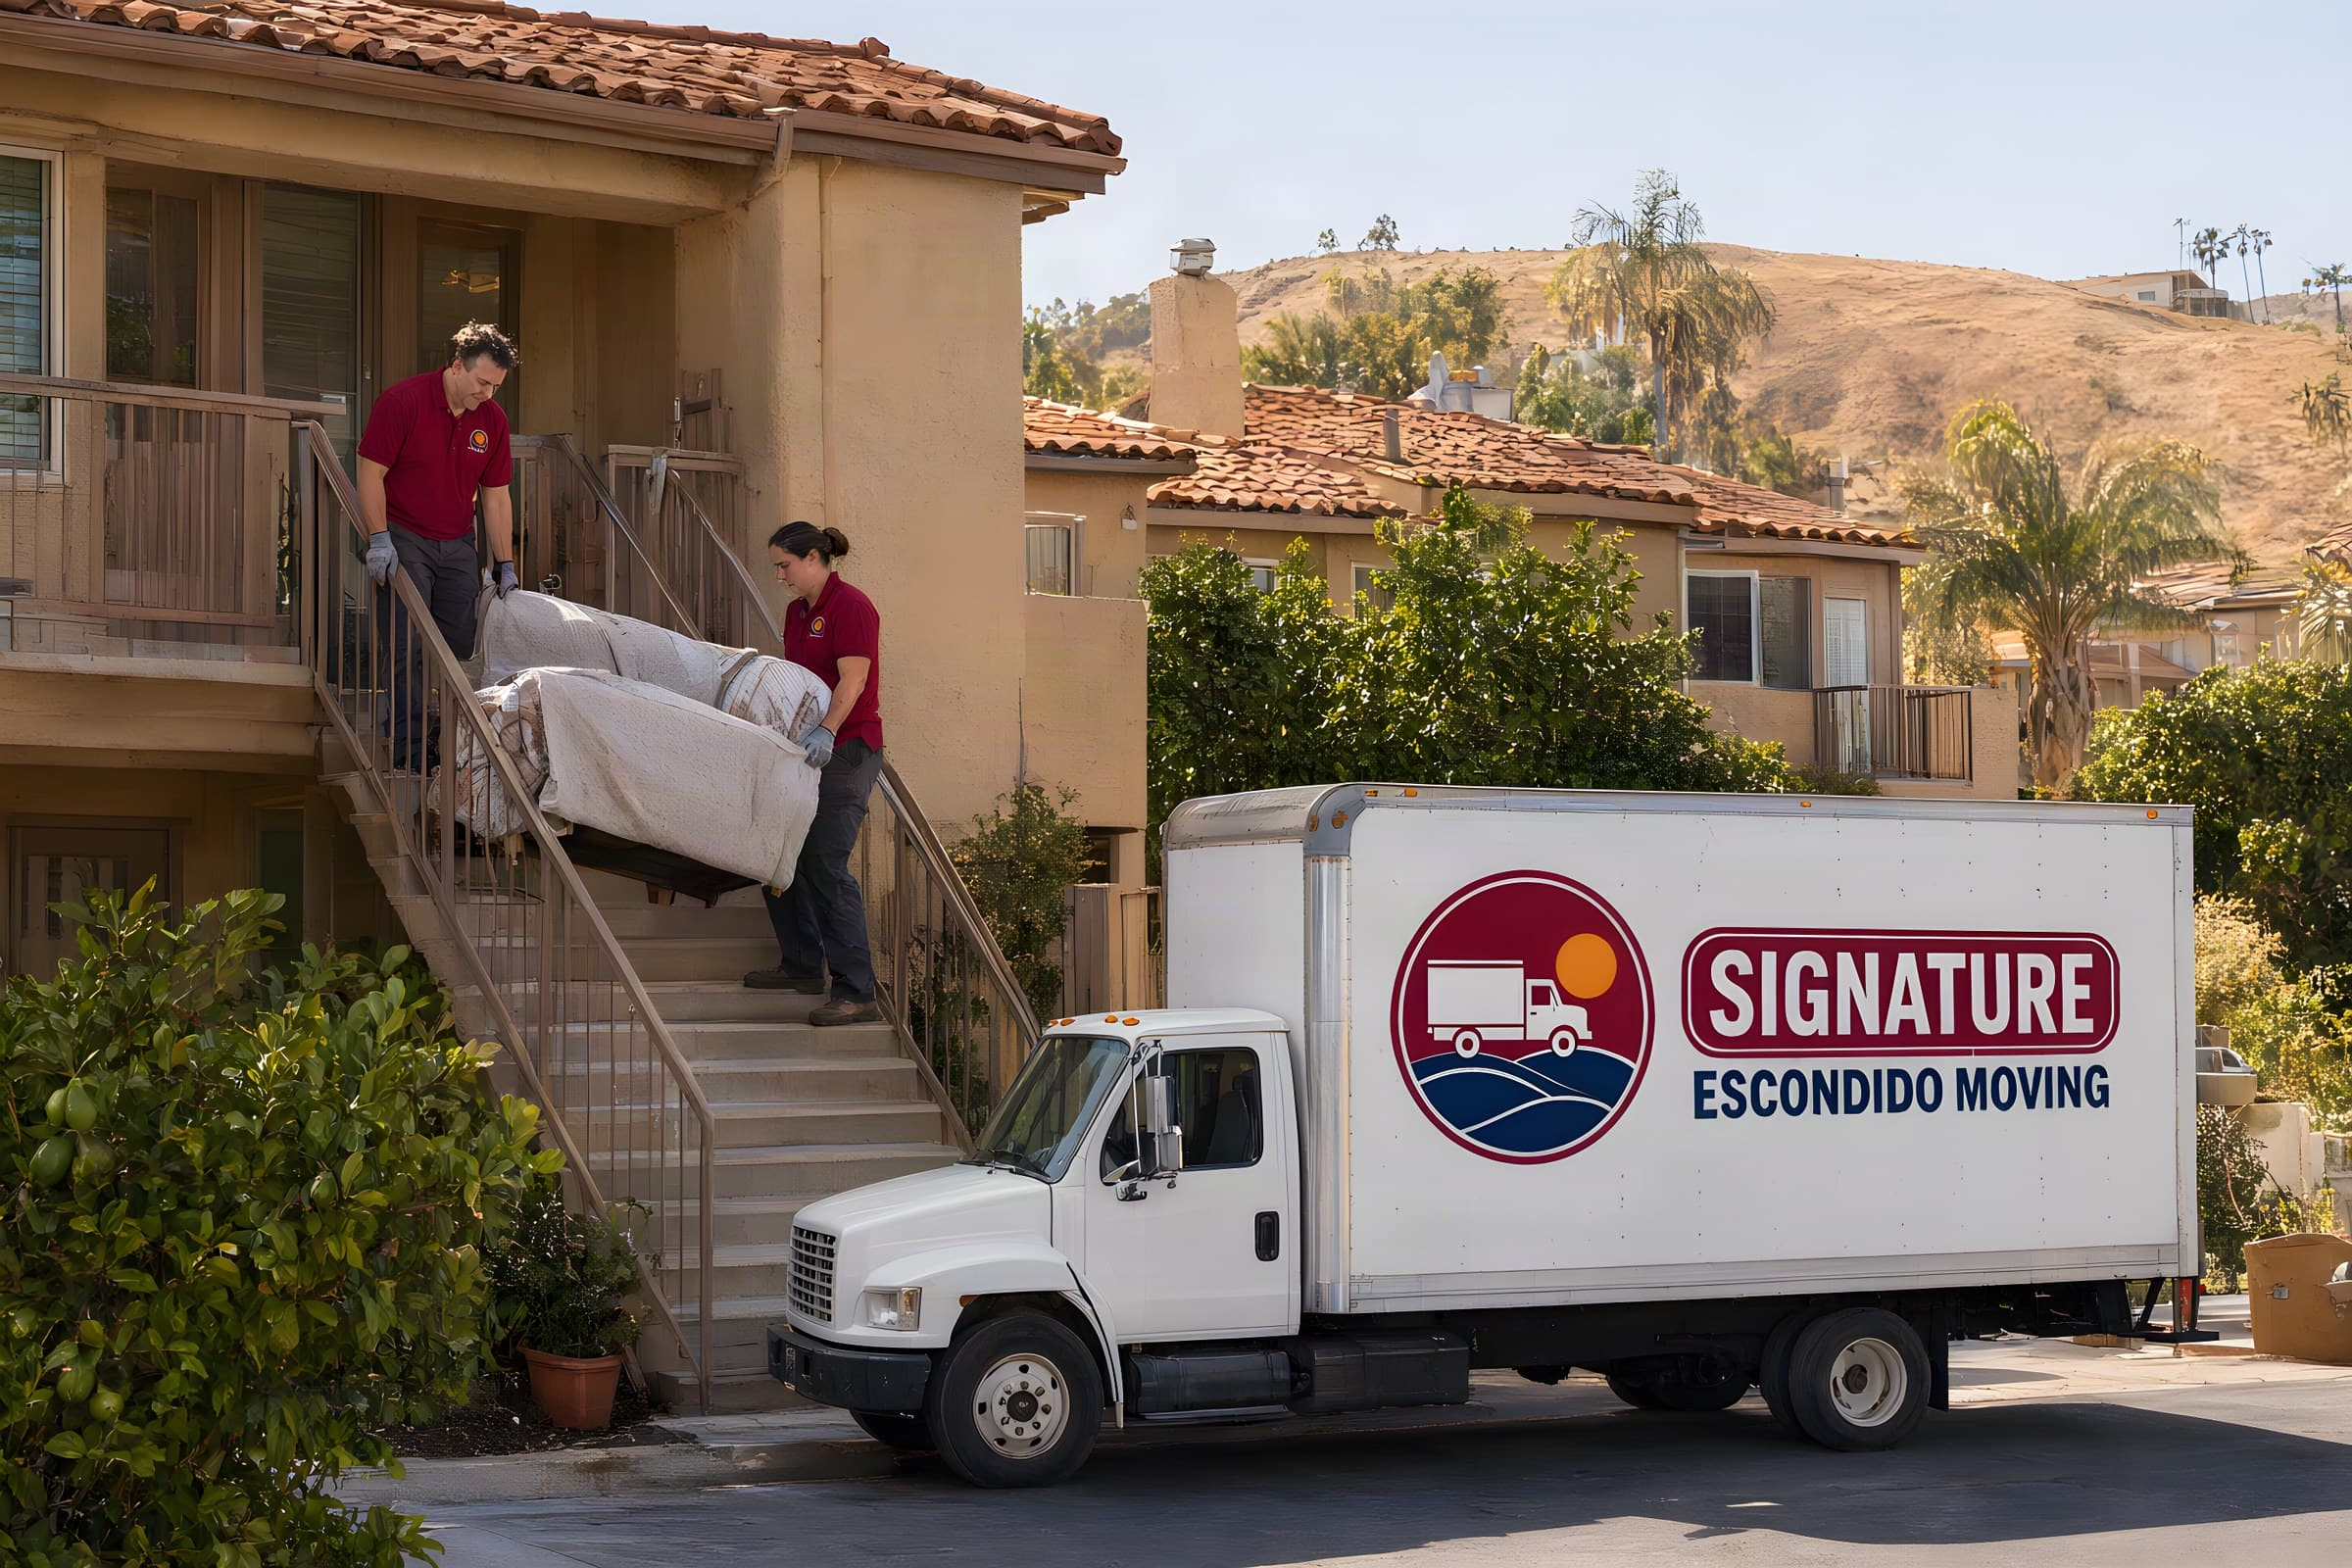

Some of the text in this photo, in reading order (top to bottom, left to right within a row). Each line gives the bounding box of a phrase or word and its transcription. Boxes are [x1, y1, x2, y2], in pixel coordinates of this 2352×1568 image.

[1709, 949, 2094, 1037] SIGNATURE
[1693, 1064, 2110, 1119] ESCONDIDO MOVING
